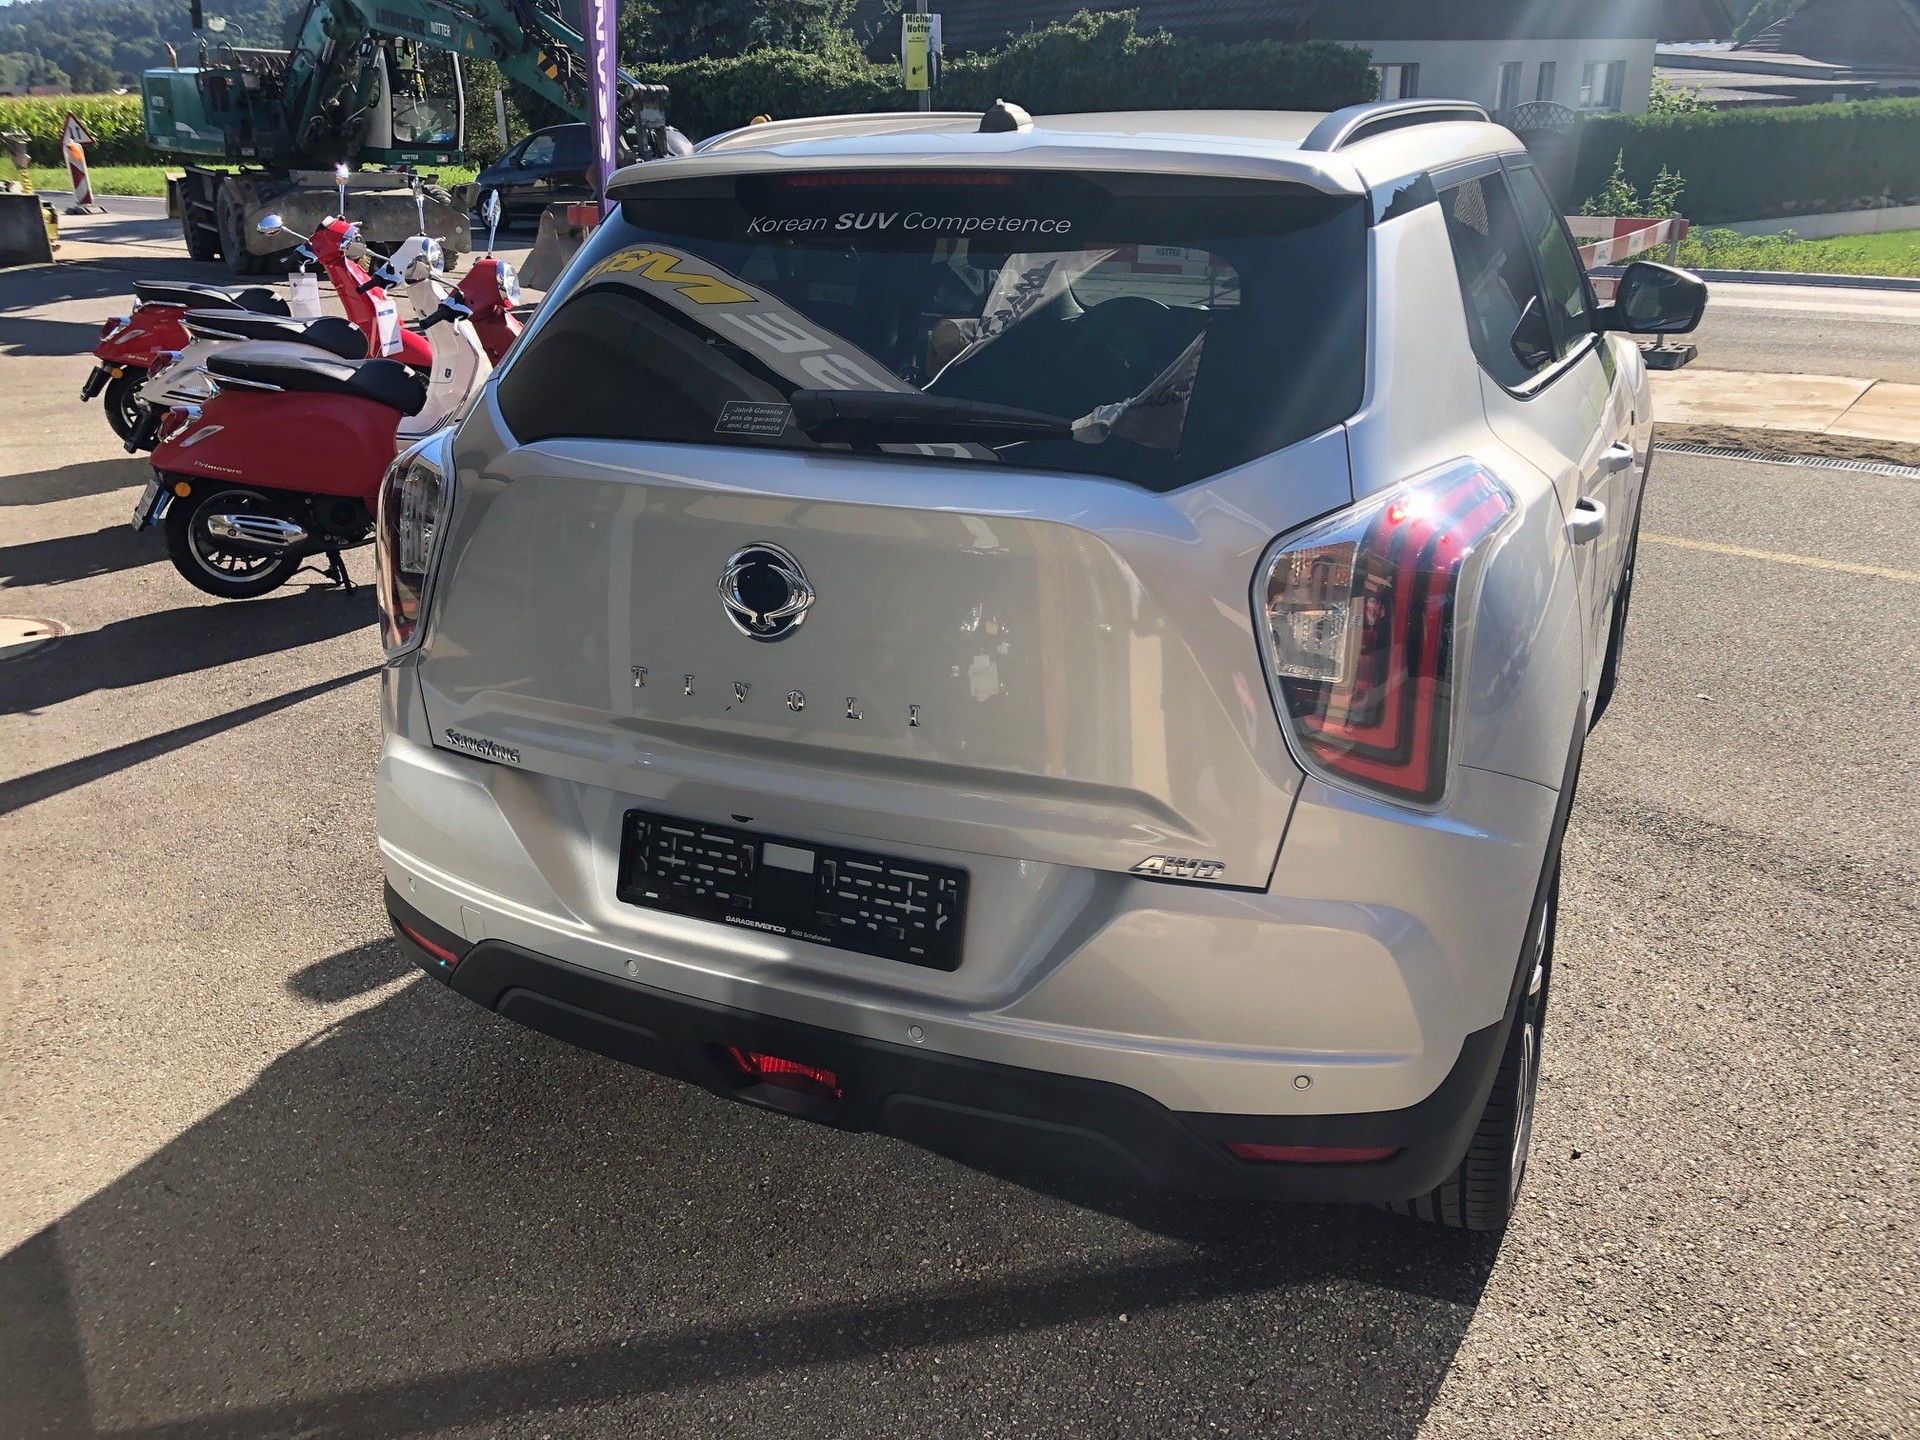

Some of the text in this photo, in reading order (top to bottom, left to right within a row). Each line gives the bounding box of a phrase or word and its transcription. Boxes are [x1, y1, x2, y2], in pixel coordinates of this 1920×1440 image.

[905, 13, 934, 23] Michael
[430, 21, 452, 38] NOTTER
[906, 23, 931, 33] Notter
[746, 211, 1072, 235] Korean SUV Competence
[722, 413, 730, 421] 5
[753, 407, 784, 416] Garantie
[631, 665, 921, 728] TIVOLI
[1128, 854, 1226, 879] AWD
